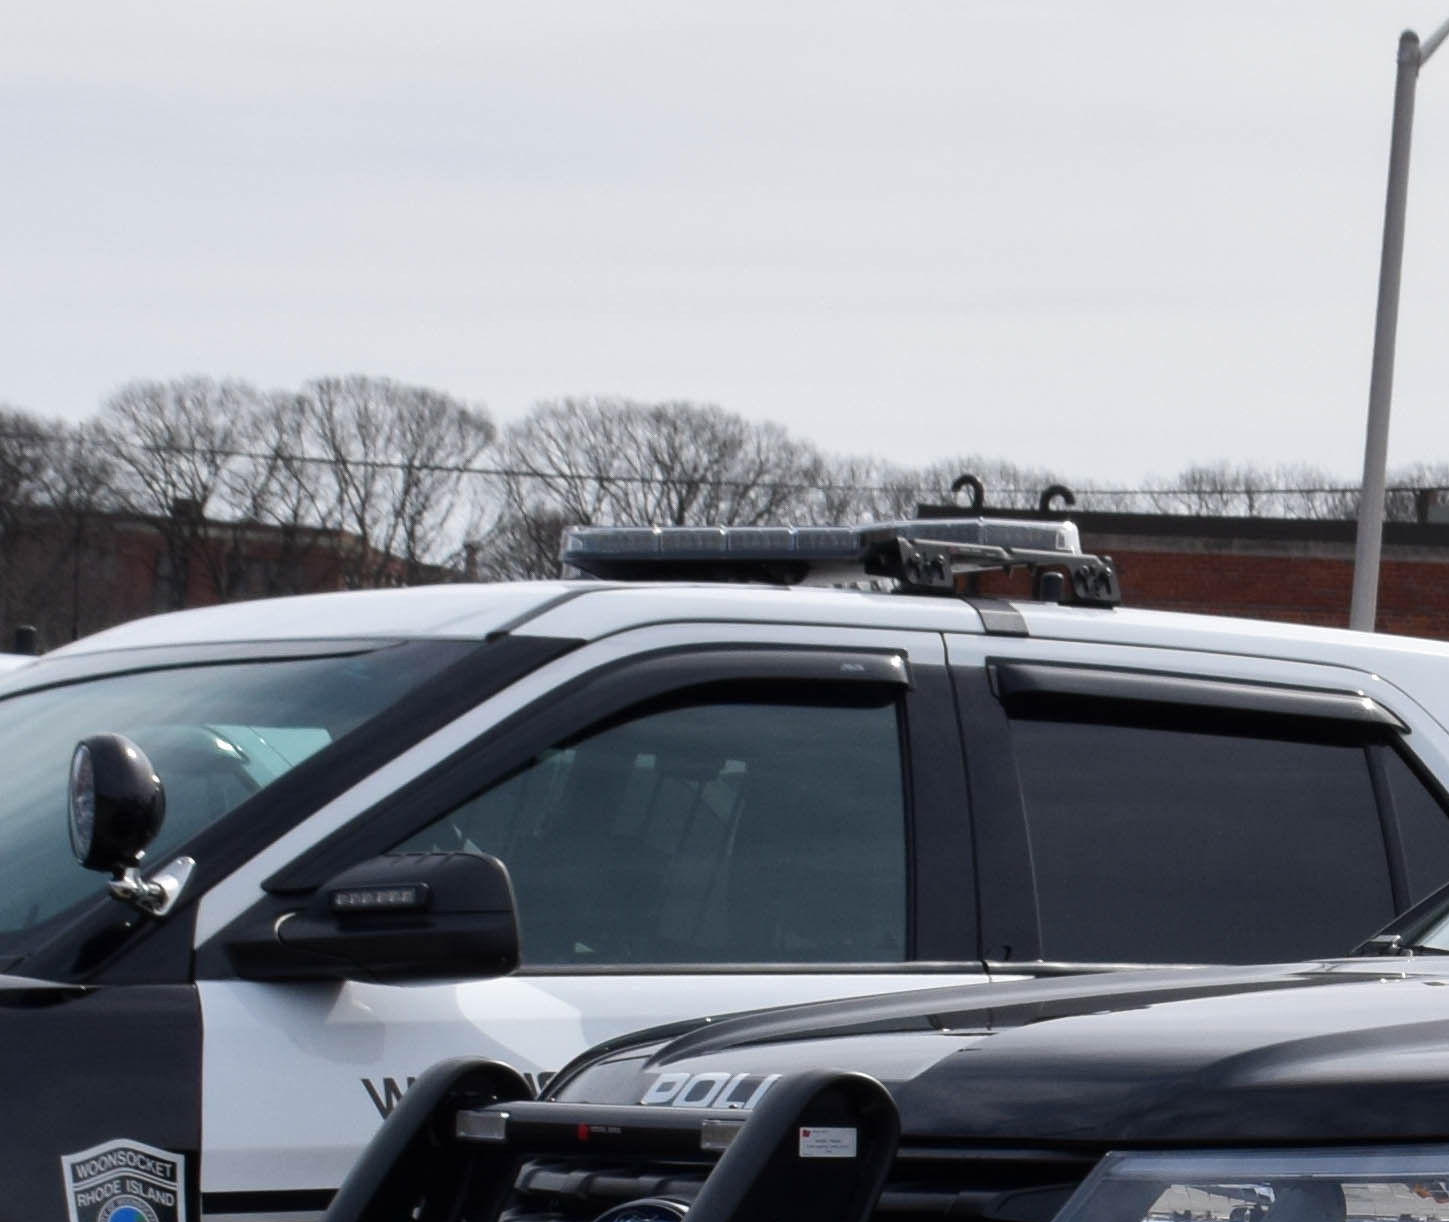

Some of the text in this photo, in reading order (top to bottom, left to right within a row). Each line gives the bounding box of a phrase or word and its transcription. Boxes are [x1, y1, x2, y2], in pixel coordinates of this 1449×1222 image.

[74, 1151, 173, 1179] WOONSOCKET
[77, 1179, 175, 1207] RHODE ISLAND
